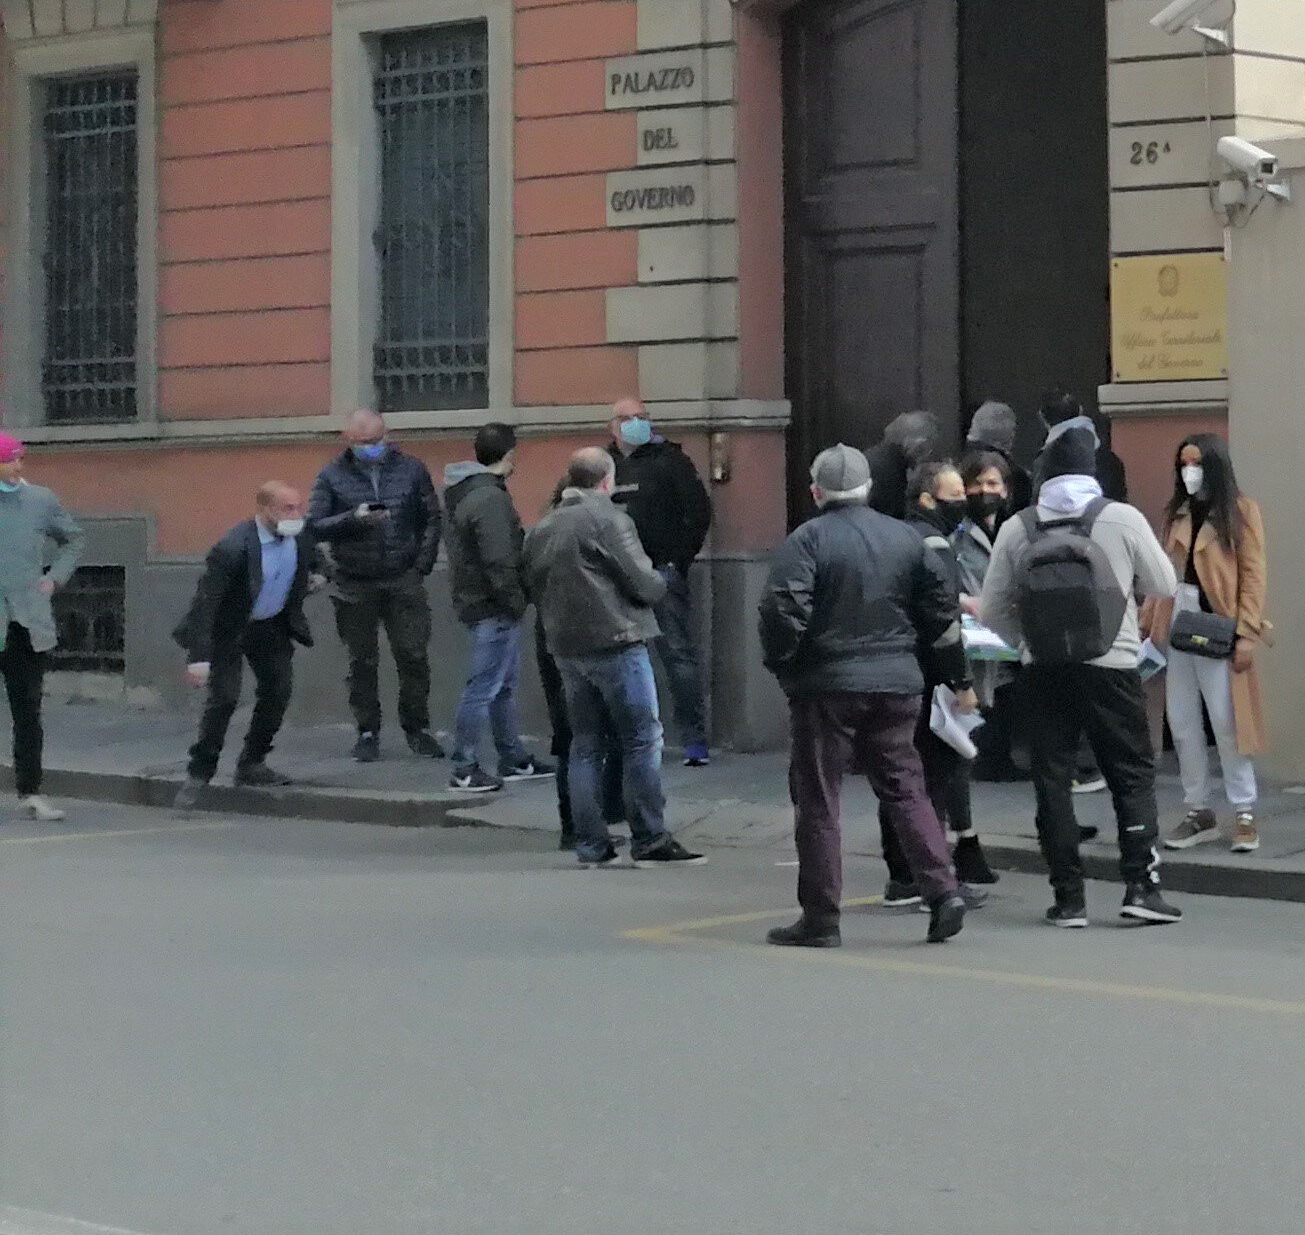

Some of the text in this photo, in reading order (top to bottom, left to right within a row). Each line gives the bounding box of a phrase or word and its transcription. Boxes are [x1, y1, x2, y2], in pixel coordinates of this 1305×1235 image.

[611, 67, 695, 95] PALAZZO
[643, 127, 679, 151] DEL
[611, 185, 695, 212] GOVERNO
